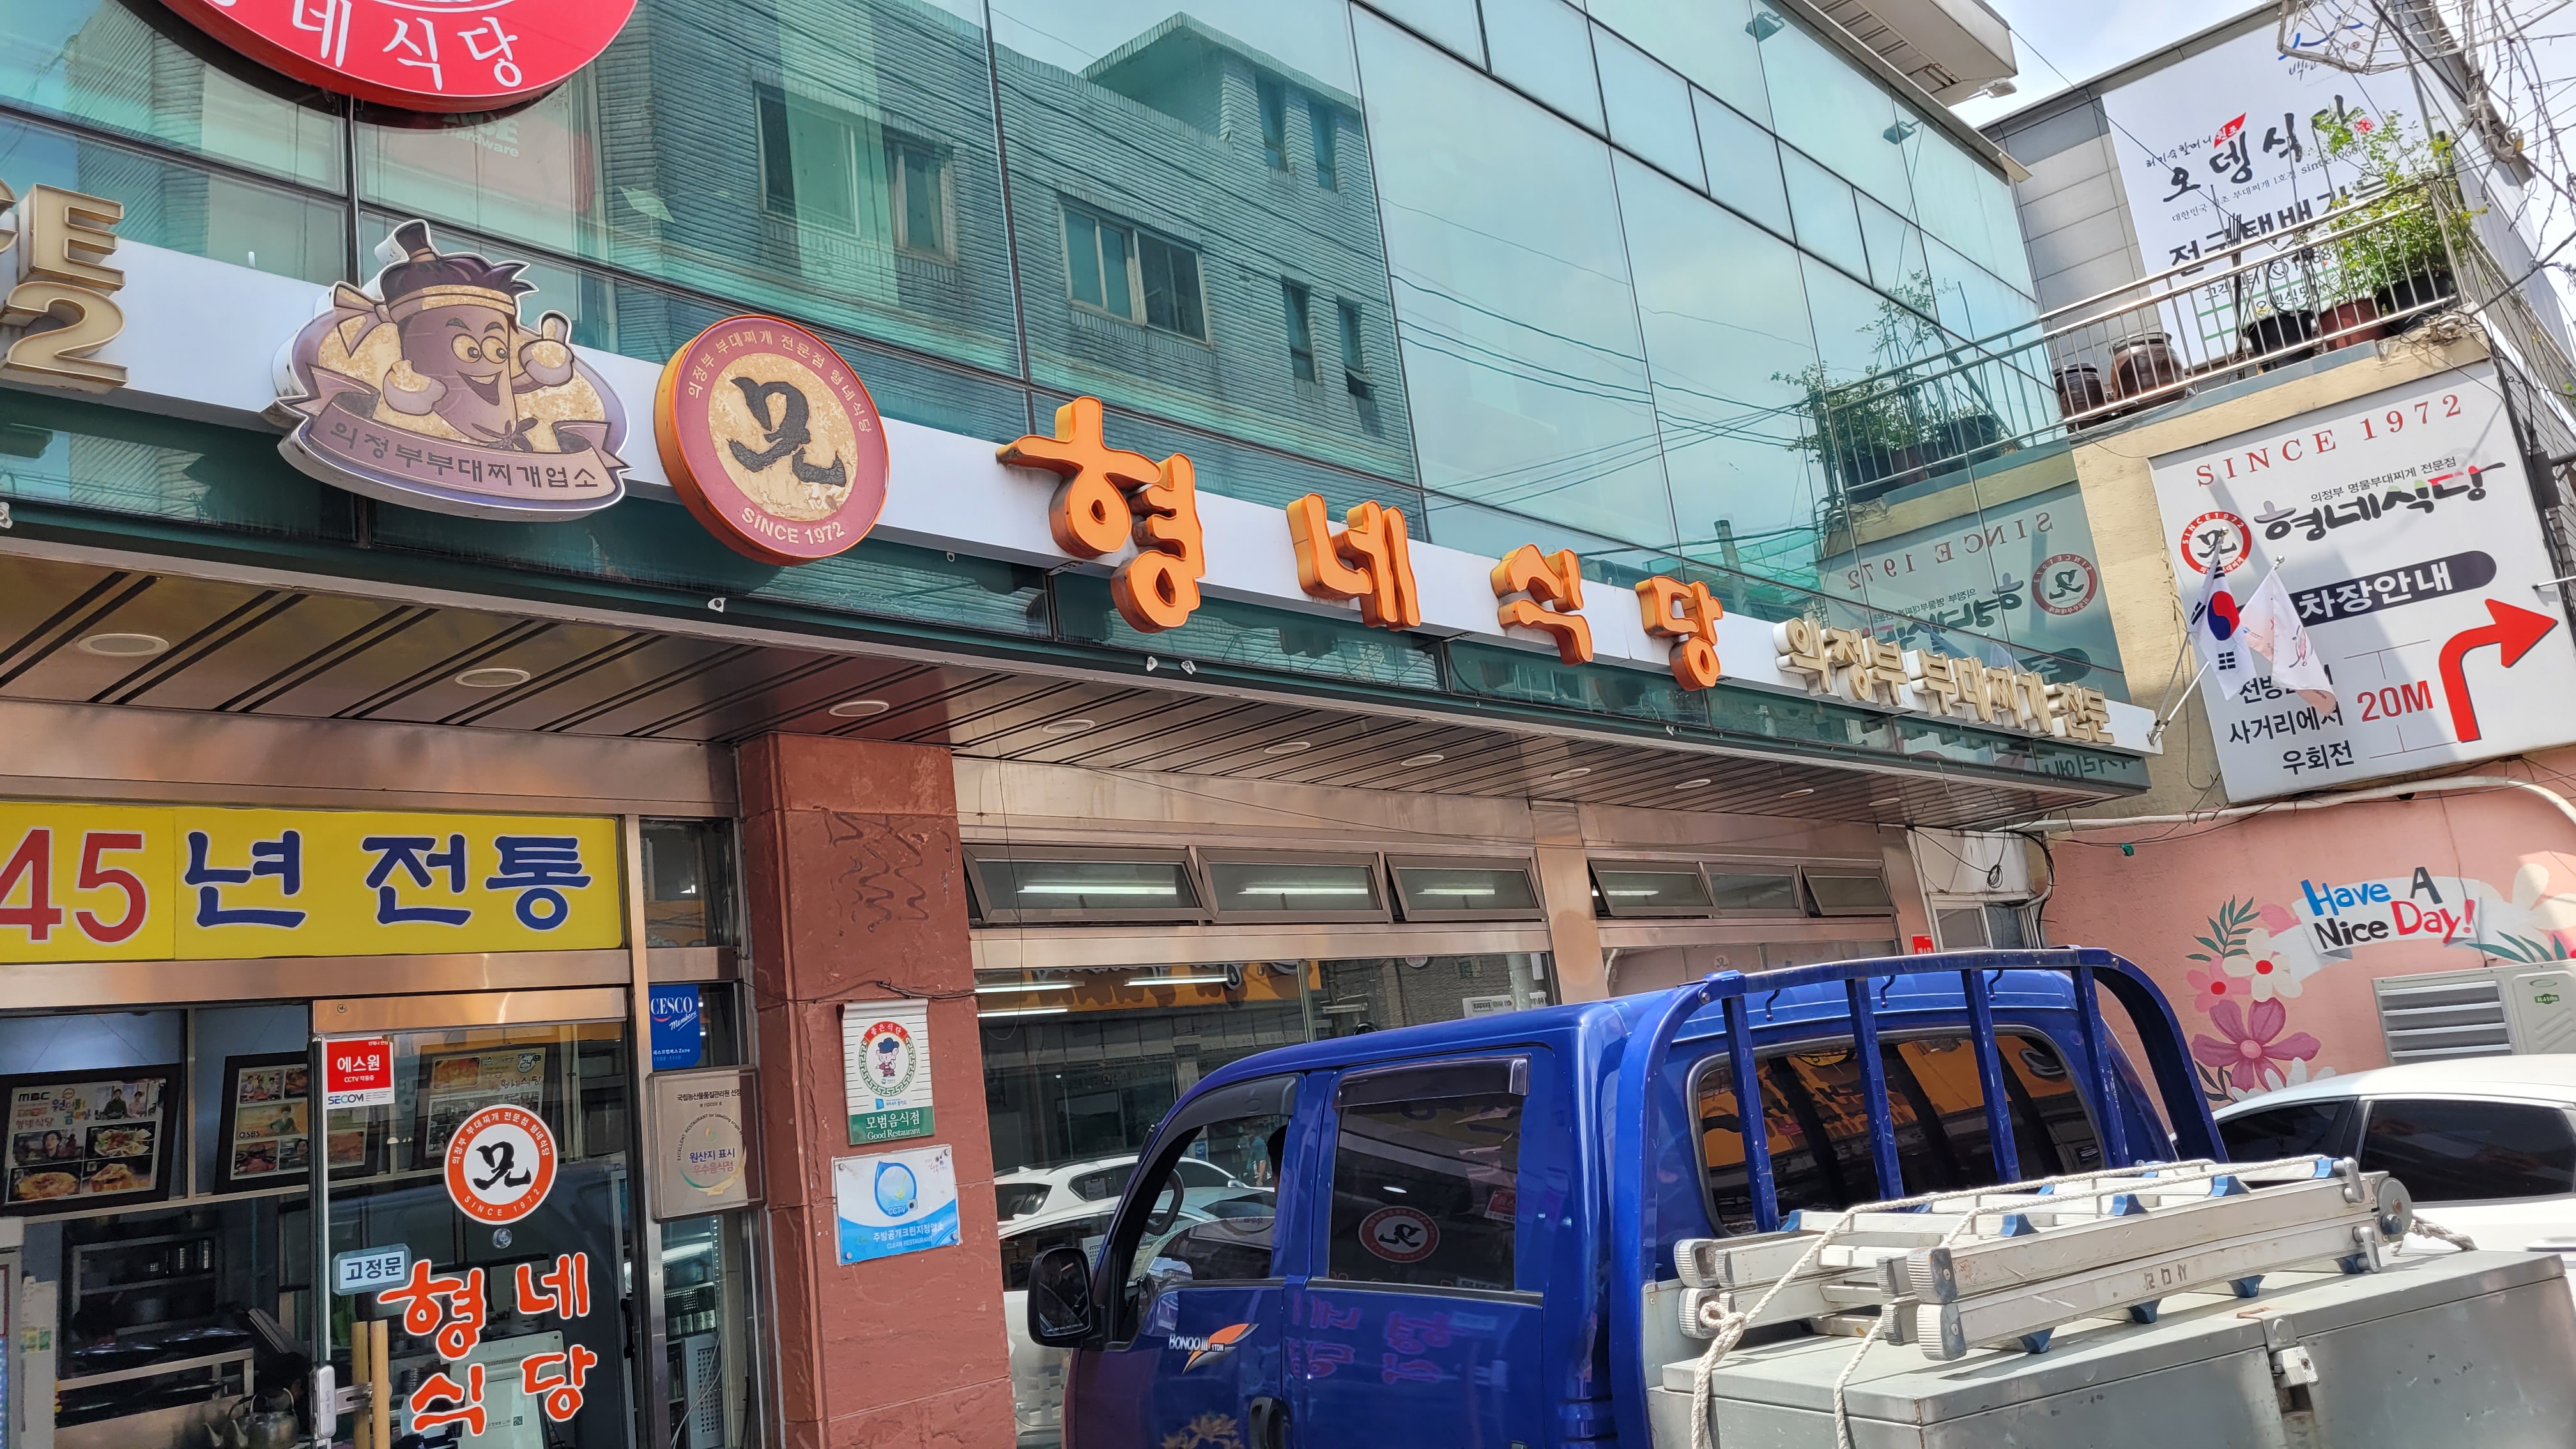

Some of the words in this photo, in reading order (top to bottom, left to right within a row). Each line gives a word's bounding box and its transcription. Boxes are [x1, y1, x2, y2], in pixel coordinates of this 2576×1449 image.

[222, 0, 522, 90] 네식당
[2233, 180, 2270, 199] 부대찌개
[687, 353, 716, 399] 의정부
[715, 330, 773, 355] 부대찌개
[781, 334, 825, 368] 전문점
[329, 422, 599, 488] 의정부부대찌개업소
[2196, 429, 2336, 487] SINCE
[2360, 394, 2462, 441] 1972
[2310, 486, 2344, 503] 의정부
[2420, 456, 2457, 474] 전문점
[2254, 461, 2506, 541] 형네식당
[742, 507, 799, 544] SINCE
[805, 521, 845, 545] 1972
[2299, 560, 2452, 619] 차장안내
[1774, 617, 1908, 707] 의정부
[1906, 648, 2053, 735] 부대찌개
[2046, 681, 2113, 744] 전문
[2357, 680, 2434, 723] 20M
[2229, 702, 2344, 745] 사거리에서
[2281, 740, 2355, 776] 우회전
[362, 832, 593, 932] 전통
[2300, 878, 2391, 917] Have
[2409, 866, 2443, 905] A
[2313, 917, 2389, 949] Nice
[2391, 898, 2476, 945] Day!
[650, 996, 693, 1015] CESCO
[669, 1010, 697, 1031] Members
[870, 1023, 902, 1036] 좋은식단
[337, 1054, 380, 1073] 에스원
[19, 1092, 50, 1101] MBC
[328, 1093, 364, 1105] SECOM
[685, 1114, 709, 1133] RESTAURANT
[866, 1110, 920, 1130] 모범음식점
[867, 1130, 886, 1140] Good
[887, 1127, 921, 1137] Restaurant
[452, 1137, 467, 1165] 의정부
[466, 1112, 499, 1135] 부대찌개
[504, 1112, 529, 1126] 전문점
[530, 1124, 551, 1156] 형네식당
[689, 1150, 716, 1163] 원산지
[718, 1147, 735, 1158] 표시
[693, 1160, 733, 1175] 우수음식점
[464, 1195, 502, 1216] SINCE
[512, 1188, 540, 1213] 1972
[873, 1222, 944, 1243] 주방공개크린지정업소
[887, 1240, 903, 1250] CLEAN
[903, 1236, 933, 1246] RESTAURANT
[345, 1255, 402, 1283] 고정문
